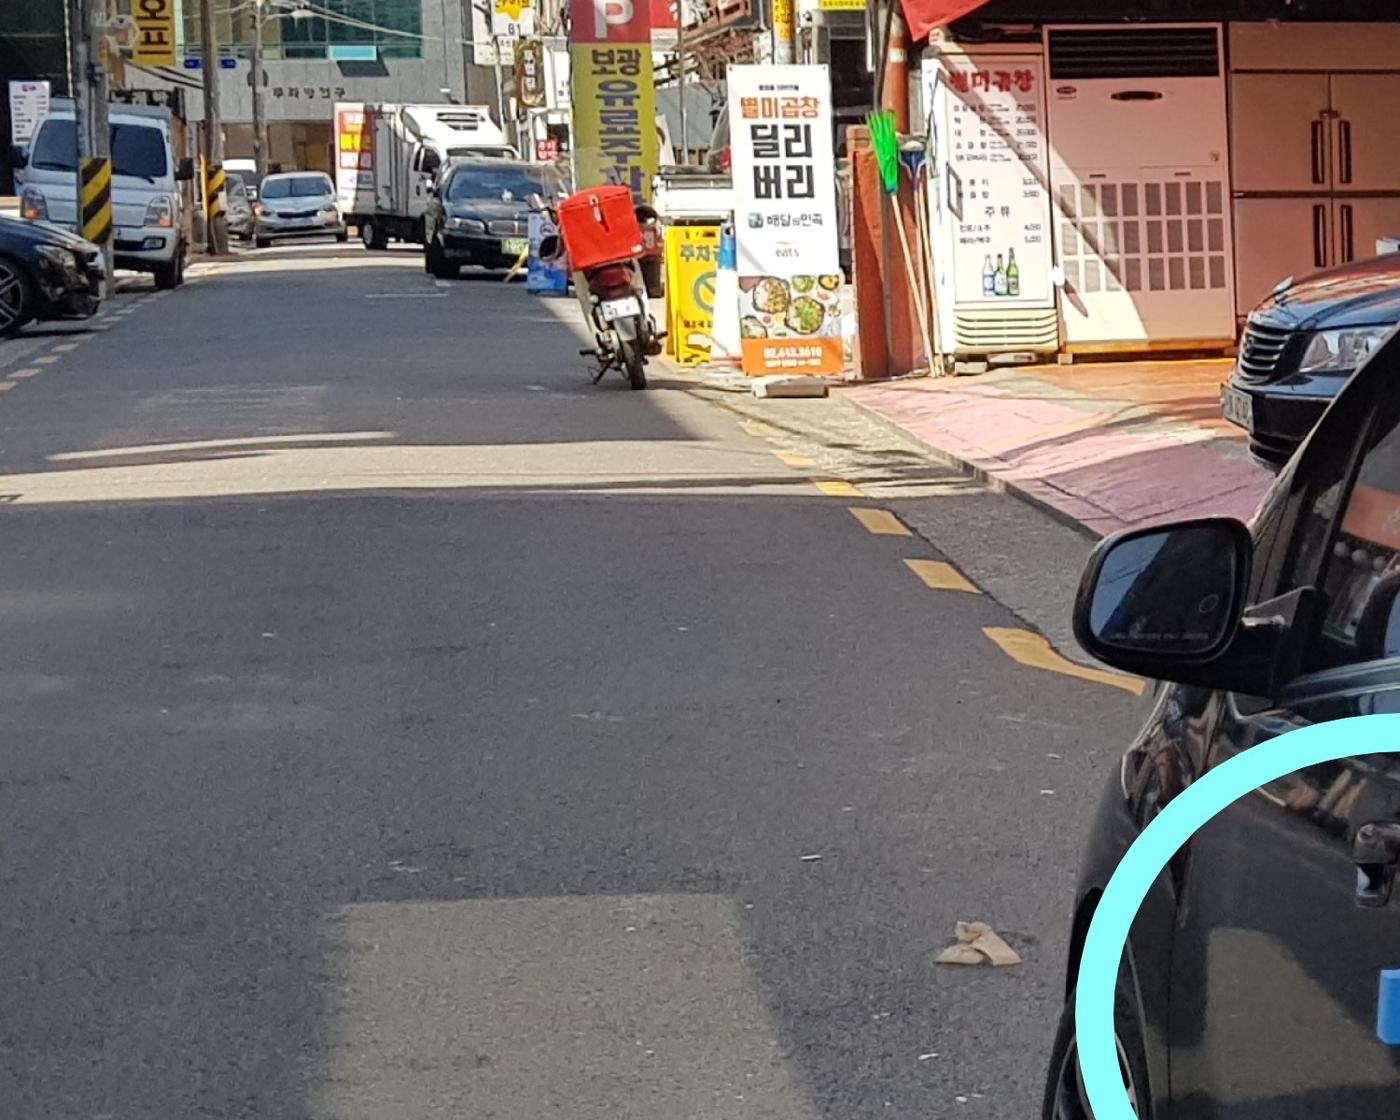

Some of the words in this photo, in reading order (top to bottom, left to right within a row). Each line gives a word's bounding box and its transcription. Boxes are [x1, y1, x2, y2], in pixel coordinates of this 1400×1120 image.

[591, 49, 641, 76] 보광
[740, 97, 820, 119] 별미곱창
[750, 124, 813, 159] 딜리
[753, 165, 815, 199] 버리
